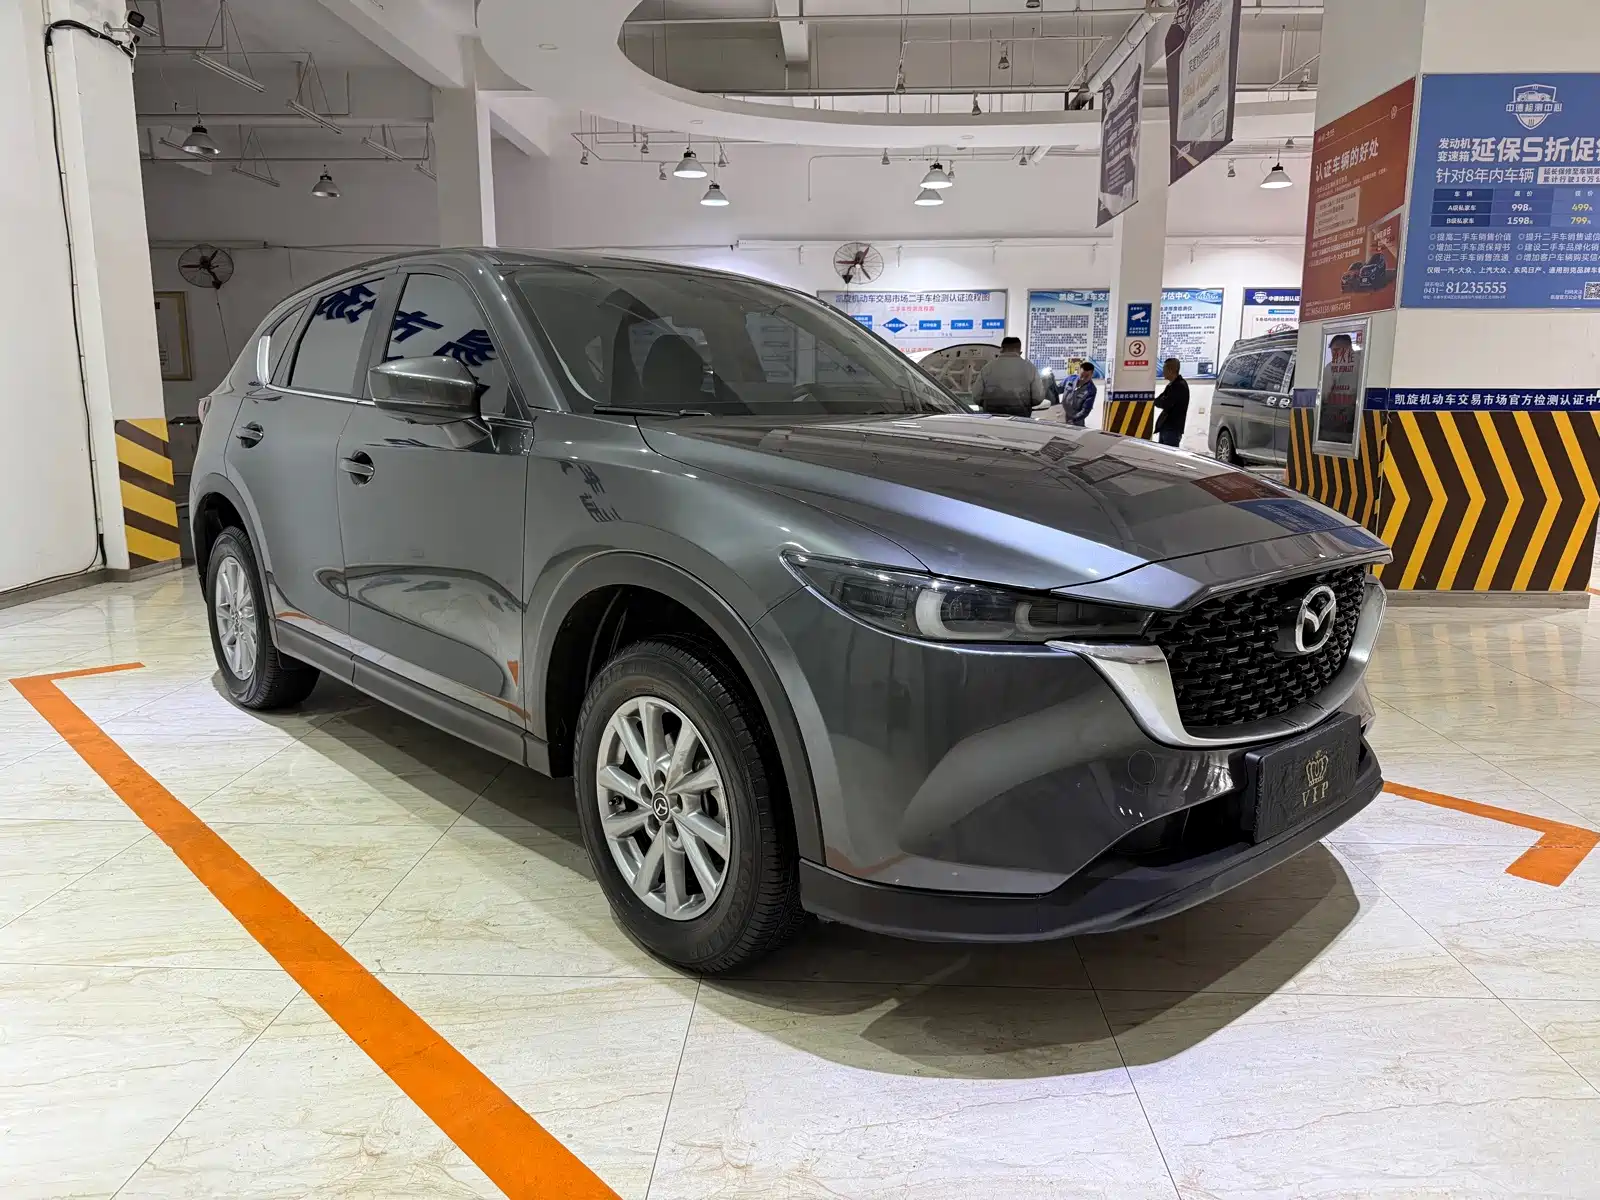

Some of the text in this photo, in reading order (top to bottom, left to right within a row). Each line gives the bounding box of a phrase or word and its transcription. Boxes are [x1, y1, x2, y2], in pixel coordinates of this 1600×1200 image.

[1438, 138, 1471, 149] 发动机
[1471, 137, 1600, 162] 延保5折促
[1315, 137, 1379, 182] 认证车辆的好处
[1437, 151, 1470, 162] 变速箱
[1436, 167, 1534, 183] 针对8年内车辆
[1446, 281, 1507, 293] 81235555
[1394, 393, 1600, 406] 凯旋机动车交易市场官方检测认证中
[1302, 781, 1329, 808] VIP
